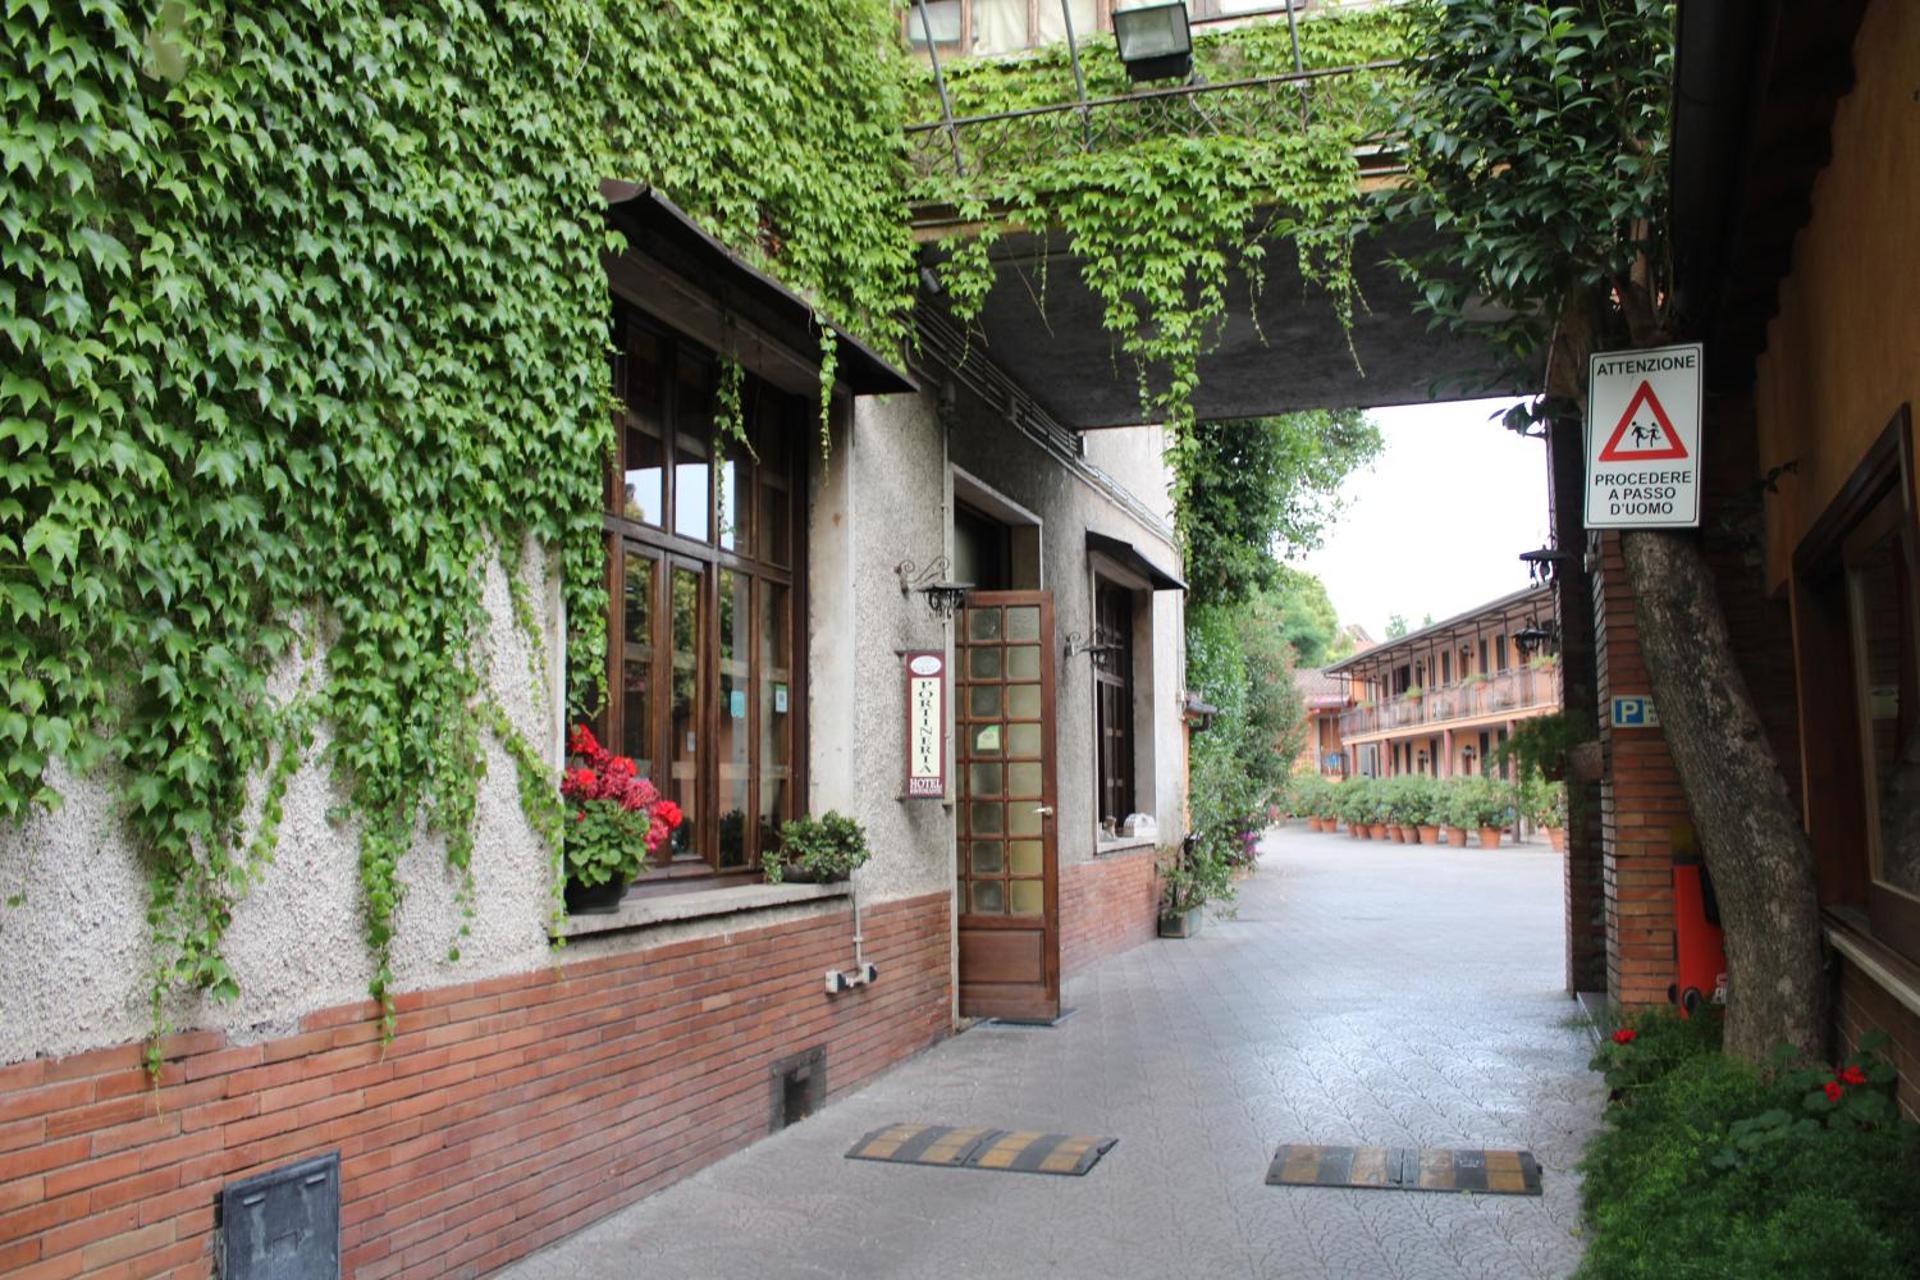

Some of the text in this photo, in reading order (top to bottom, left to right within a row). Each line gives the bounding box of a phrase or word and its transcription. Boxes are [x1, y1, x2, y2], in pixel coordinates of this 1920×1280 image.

[1597, 355, 1696, 376] ATTENZIONE
[1595, 470, 1692, 486] PROCEDERE
[1608, 486, 1676, 501] A PASSO
[1610, 502, 1673, 516] D'UOMO
[1621, 702, 1639, 723] P
[910, 778, 942, 787] HOTEL
